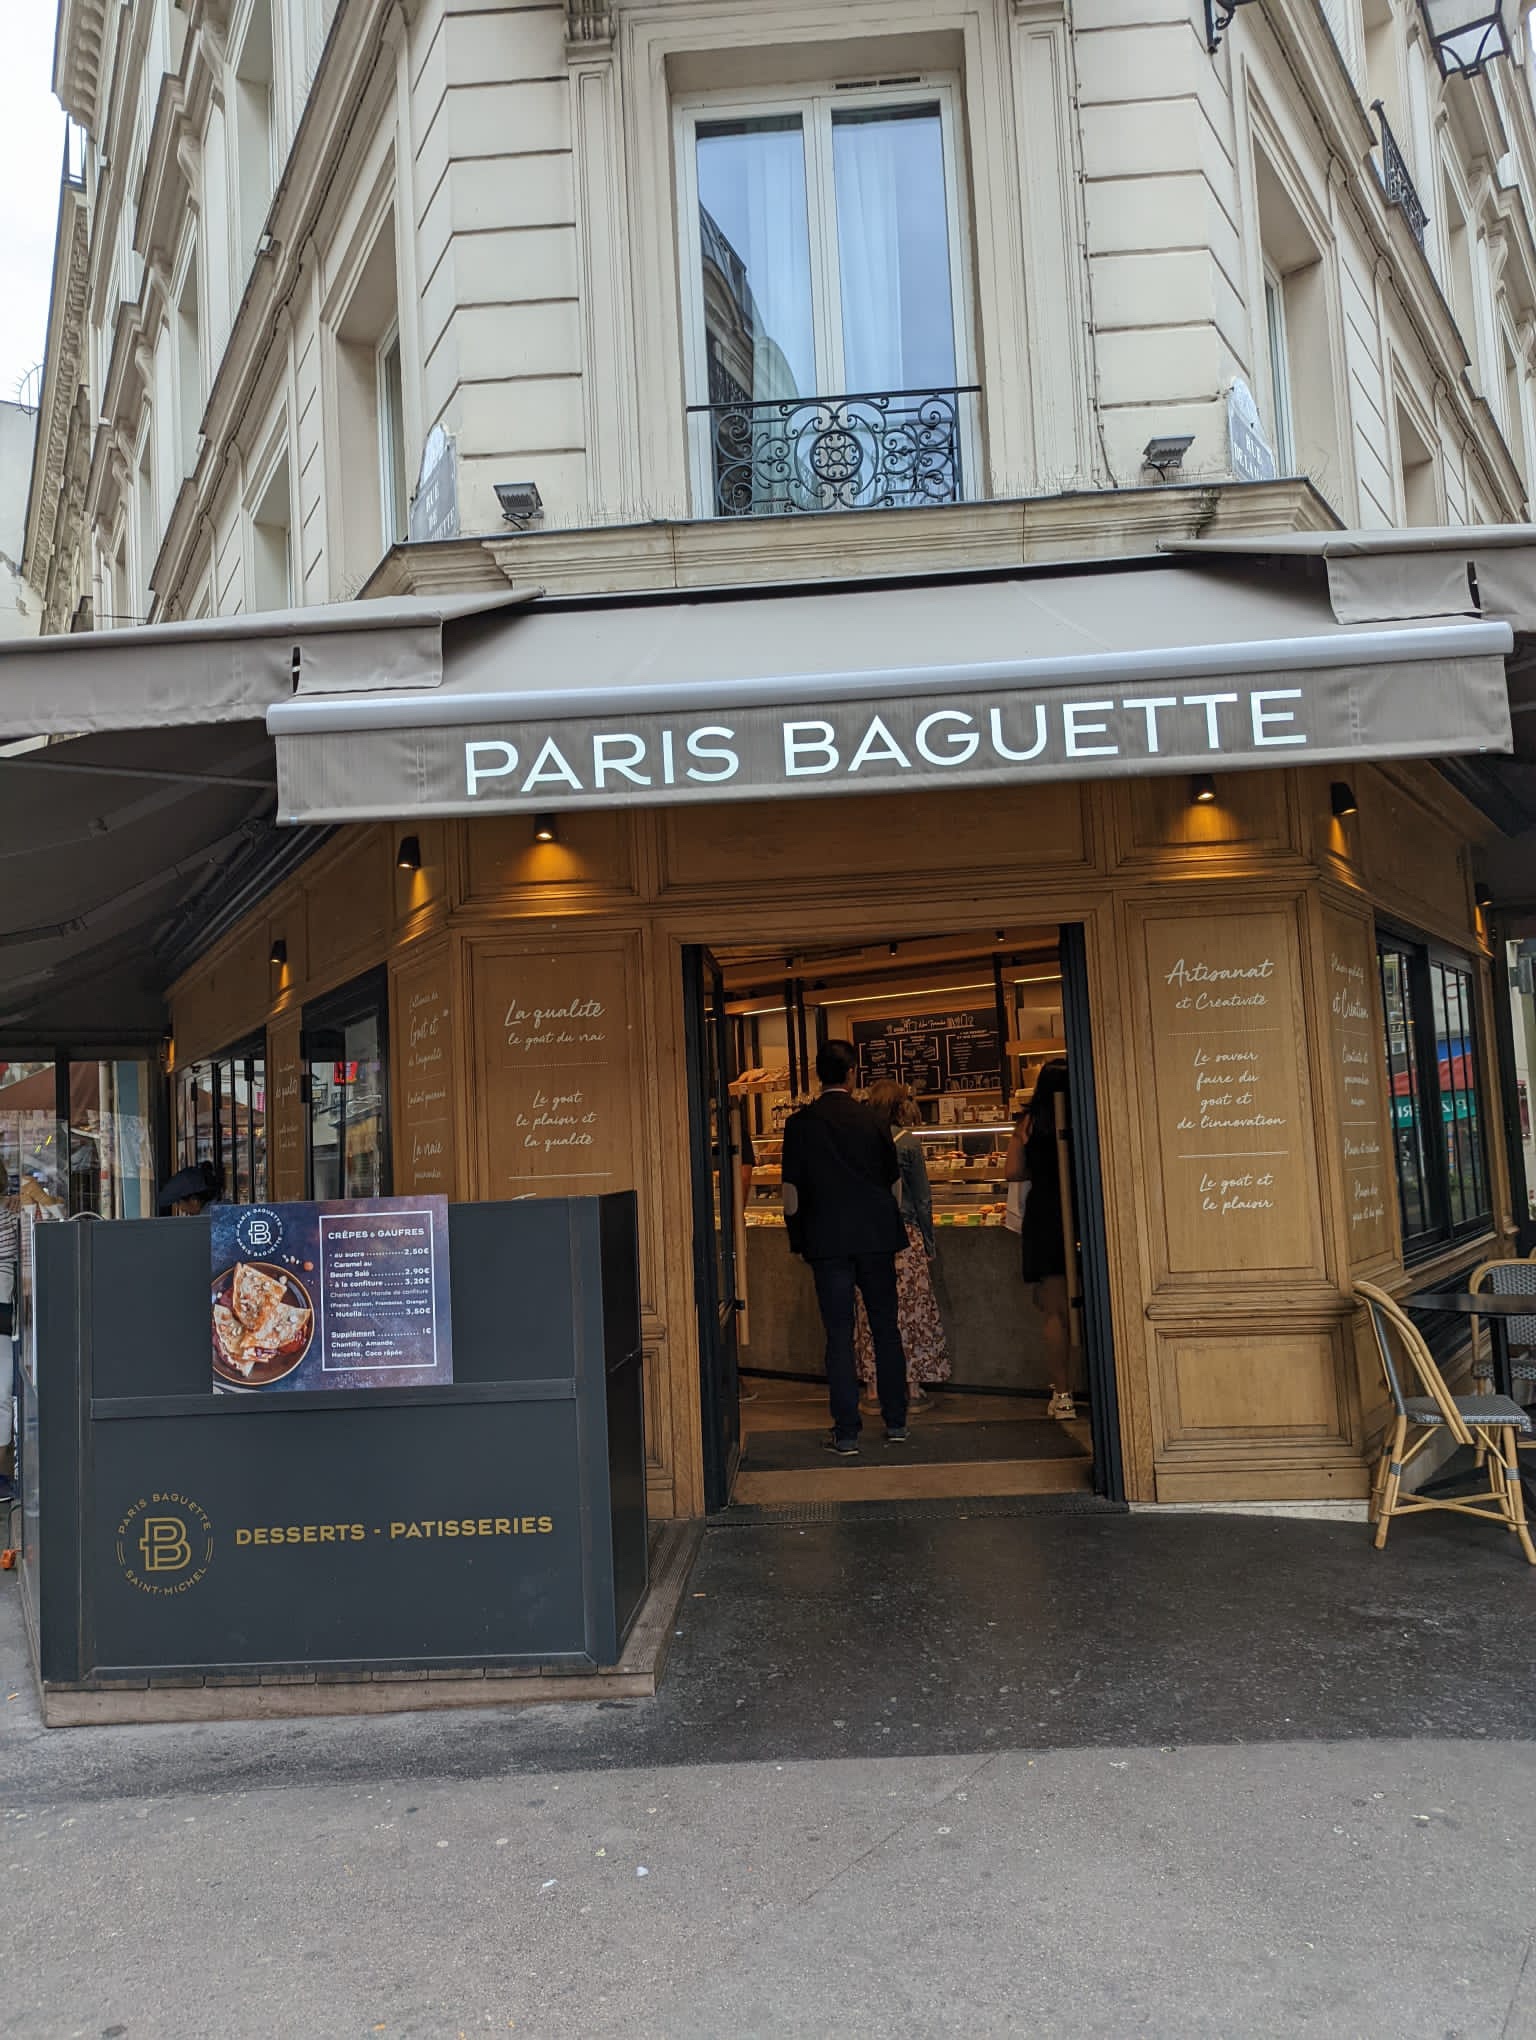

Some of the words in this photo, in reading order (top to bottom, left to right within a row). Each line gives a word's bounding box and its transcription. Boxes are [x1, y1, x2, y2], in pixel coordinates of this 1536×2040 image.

[465, 725, 739, 795] PARIS
[782, 688, 1307, 776] BAGUETTE
[1164, 958, 1274, 988] Artisanat
[1176, 996, 1191, 1009] et
[504, 999, 531, 1026] La
[508, 1033, 521, 1045] le
[556, 1031, 574, 1042] du
[579, 1032, 605, 1042] vrai
[1194, 1048, 1210, 1067] Le
[1216, 1051, 1258, 1062] savoir
[1196, 1072, 1233, 1092] faire
[1238, 1070, 1259, 1082] du
[532, 1090, 548, 1109] Le
[1235, 1092, 1253, 1104] et
[516, 1113, 529, 1126] le
[532, 1112, 578, 1131] plaisir
[582, 1111, 597, 1123] et
[1177, 1116, 1196, 1128] de
[524, 1134, 540, 1147] la
[1200, 1173, 1216, 1192] Le
[1257, 1173, 1274, 1186] et
[1203, 1197, 1218, 1210] le
[1222, 1195, 1274, 1215] plaisir
[328, 1230, 368, 1240] CRÊPES
[377, 1228, 425, 1238] GAUFRES
[335, 1310, 362, 1318] Nutella
[118, 1498, 147, 1534] PARIS
[152, 1492, 212, 1532] BAGUETTE
[235, 1524, 366, 1545] DESSERTS
[390, 1516, 553, 1539] PATISSERIES
[125, 1567, 207, 1596] SAINT-MICHEL
